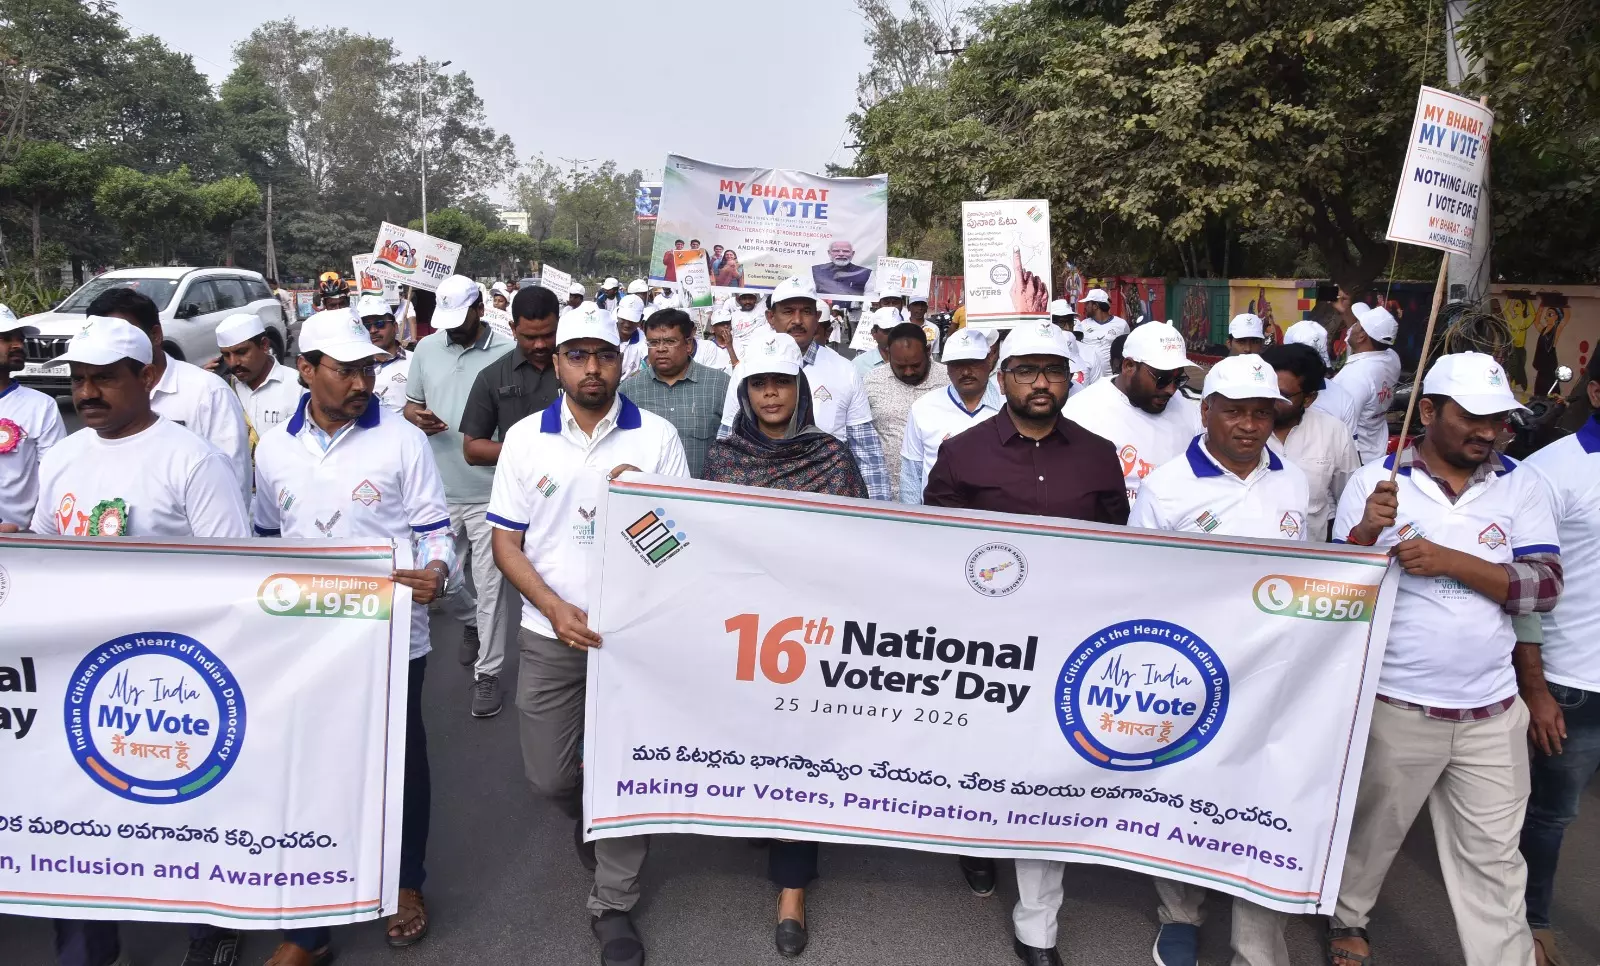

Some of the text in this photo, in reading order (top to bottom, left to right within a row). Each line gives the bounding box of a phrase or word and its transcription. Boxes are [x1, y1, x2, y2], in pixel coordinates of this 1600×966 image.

[1424, 104, 1483, 137] MY BHARAT
[1419, 123, 1446, 148] MY
[1451, 130, 1479, 160] VOTE
[720, 180, 829, 201] MY BHARAT
[1414, 167, 1478, 198] NOTHING LIKE
[717, 194, 753, 213] MY
[763, 199, 828, 219] VOTE
[998, 217, 1017, 226] ఓటు
[1427, 193, 1432, 207] I
[1436, 194, 1456, 213] VOTE
[1456, 201, 1473, 220] FOR
[1429, 216, 1439, 227] MY
[1440, 219, 1460, 234] BHARAT
[784, 241, 810, 249] GUNTUR
[423, 259, 451, 277] VOTERS
[969, 289, 1002, 297] VOTERS
[312, 576, 379, 591] Helpline
[968, 545, 1025, 594] CHIEF ELECTORAL OFFICER ANDHRA PRADESH
[304, 592, 380, 617] 1950
[1304, 580, 1367, 597] Helpline
[1296, 595, 1364, 620] 1950
[841, 620, 1038, 671] National
[108, 668, 201, 706] My India
[819, 660, 1031, 713] Voters' Day
[1060, 625, 1224, 736] Indian Citizen at the Heart of Indian Democracy
[1100, 653, 1192, 689] My India
[71, 637, 238, 761] Indian Citizen at the Heart of Indian Democracy
[774, 697, 969, 727] 25 January 2026
[1087, 684, 1197, 716] My Vote
[97, 704, 210, 737] My Vote
[1099, 712, 1174, 744] मैं भारत हूँ
[110, 734, 191, 771] मैं भारत हूँ
[632, 745, 1292, 832] మన ఓటర్లను భాగస్వామ్యం చేయడం, చేరిక మరియు అవగాహన కల్పించడం.
[28, 816, 111, 838] మరియు
[117, 822, 219, 844] అవగాహన
[225, 827, 337, 855] కల్పించడం.
[617, 778, 1304, 872] Making our Voters, Participation, Inclusion and Awareness.
[31, 854, 144, 876] Inclusion
[153, 862, 200, 880] and
[208, 864, 355, 887] Awareness.
